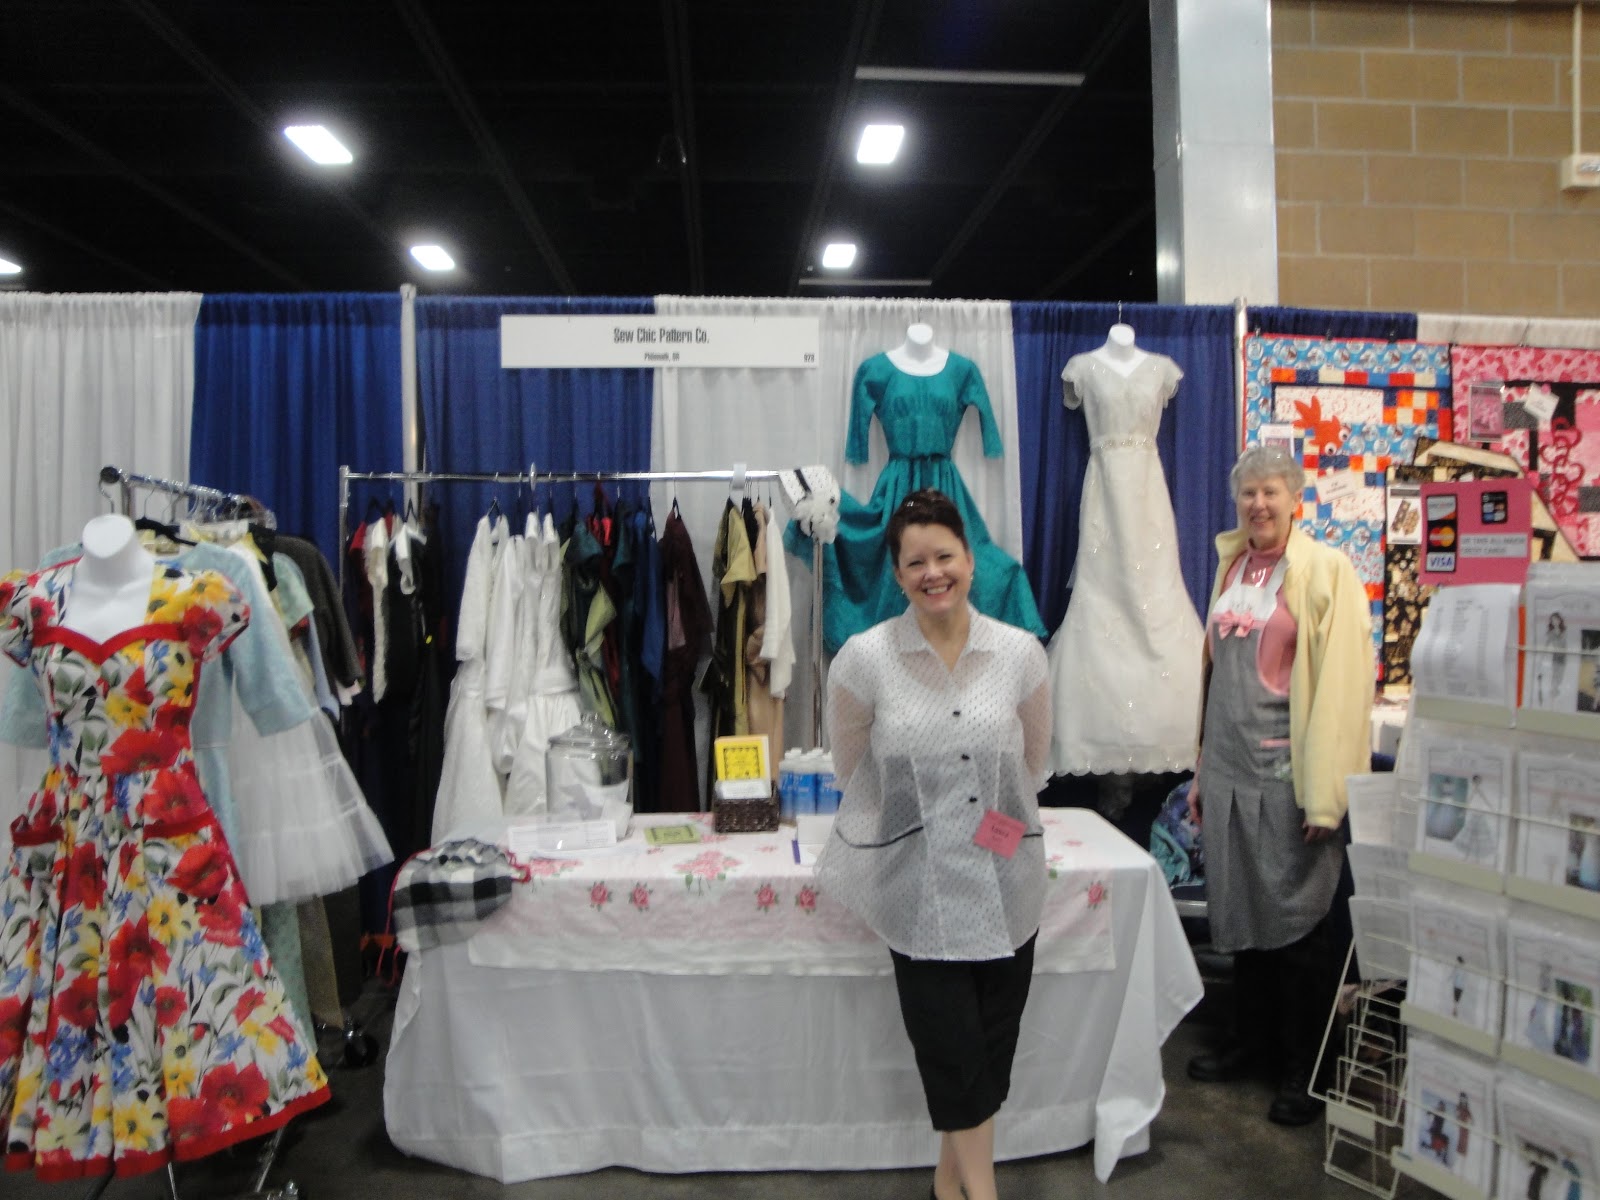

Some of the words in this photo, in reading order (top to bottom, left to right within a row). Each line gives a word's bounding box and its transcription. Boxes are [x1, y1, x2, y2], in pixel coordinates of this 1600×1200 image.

[613, 327, 634, 344] Sew
[637, 327, 657, 344] Chic
[659, 327, 693, 344] Pattern
[695, 327, 710, 344] Co.
[1430, 557, 1453, 567] VISA
